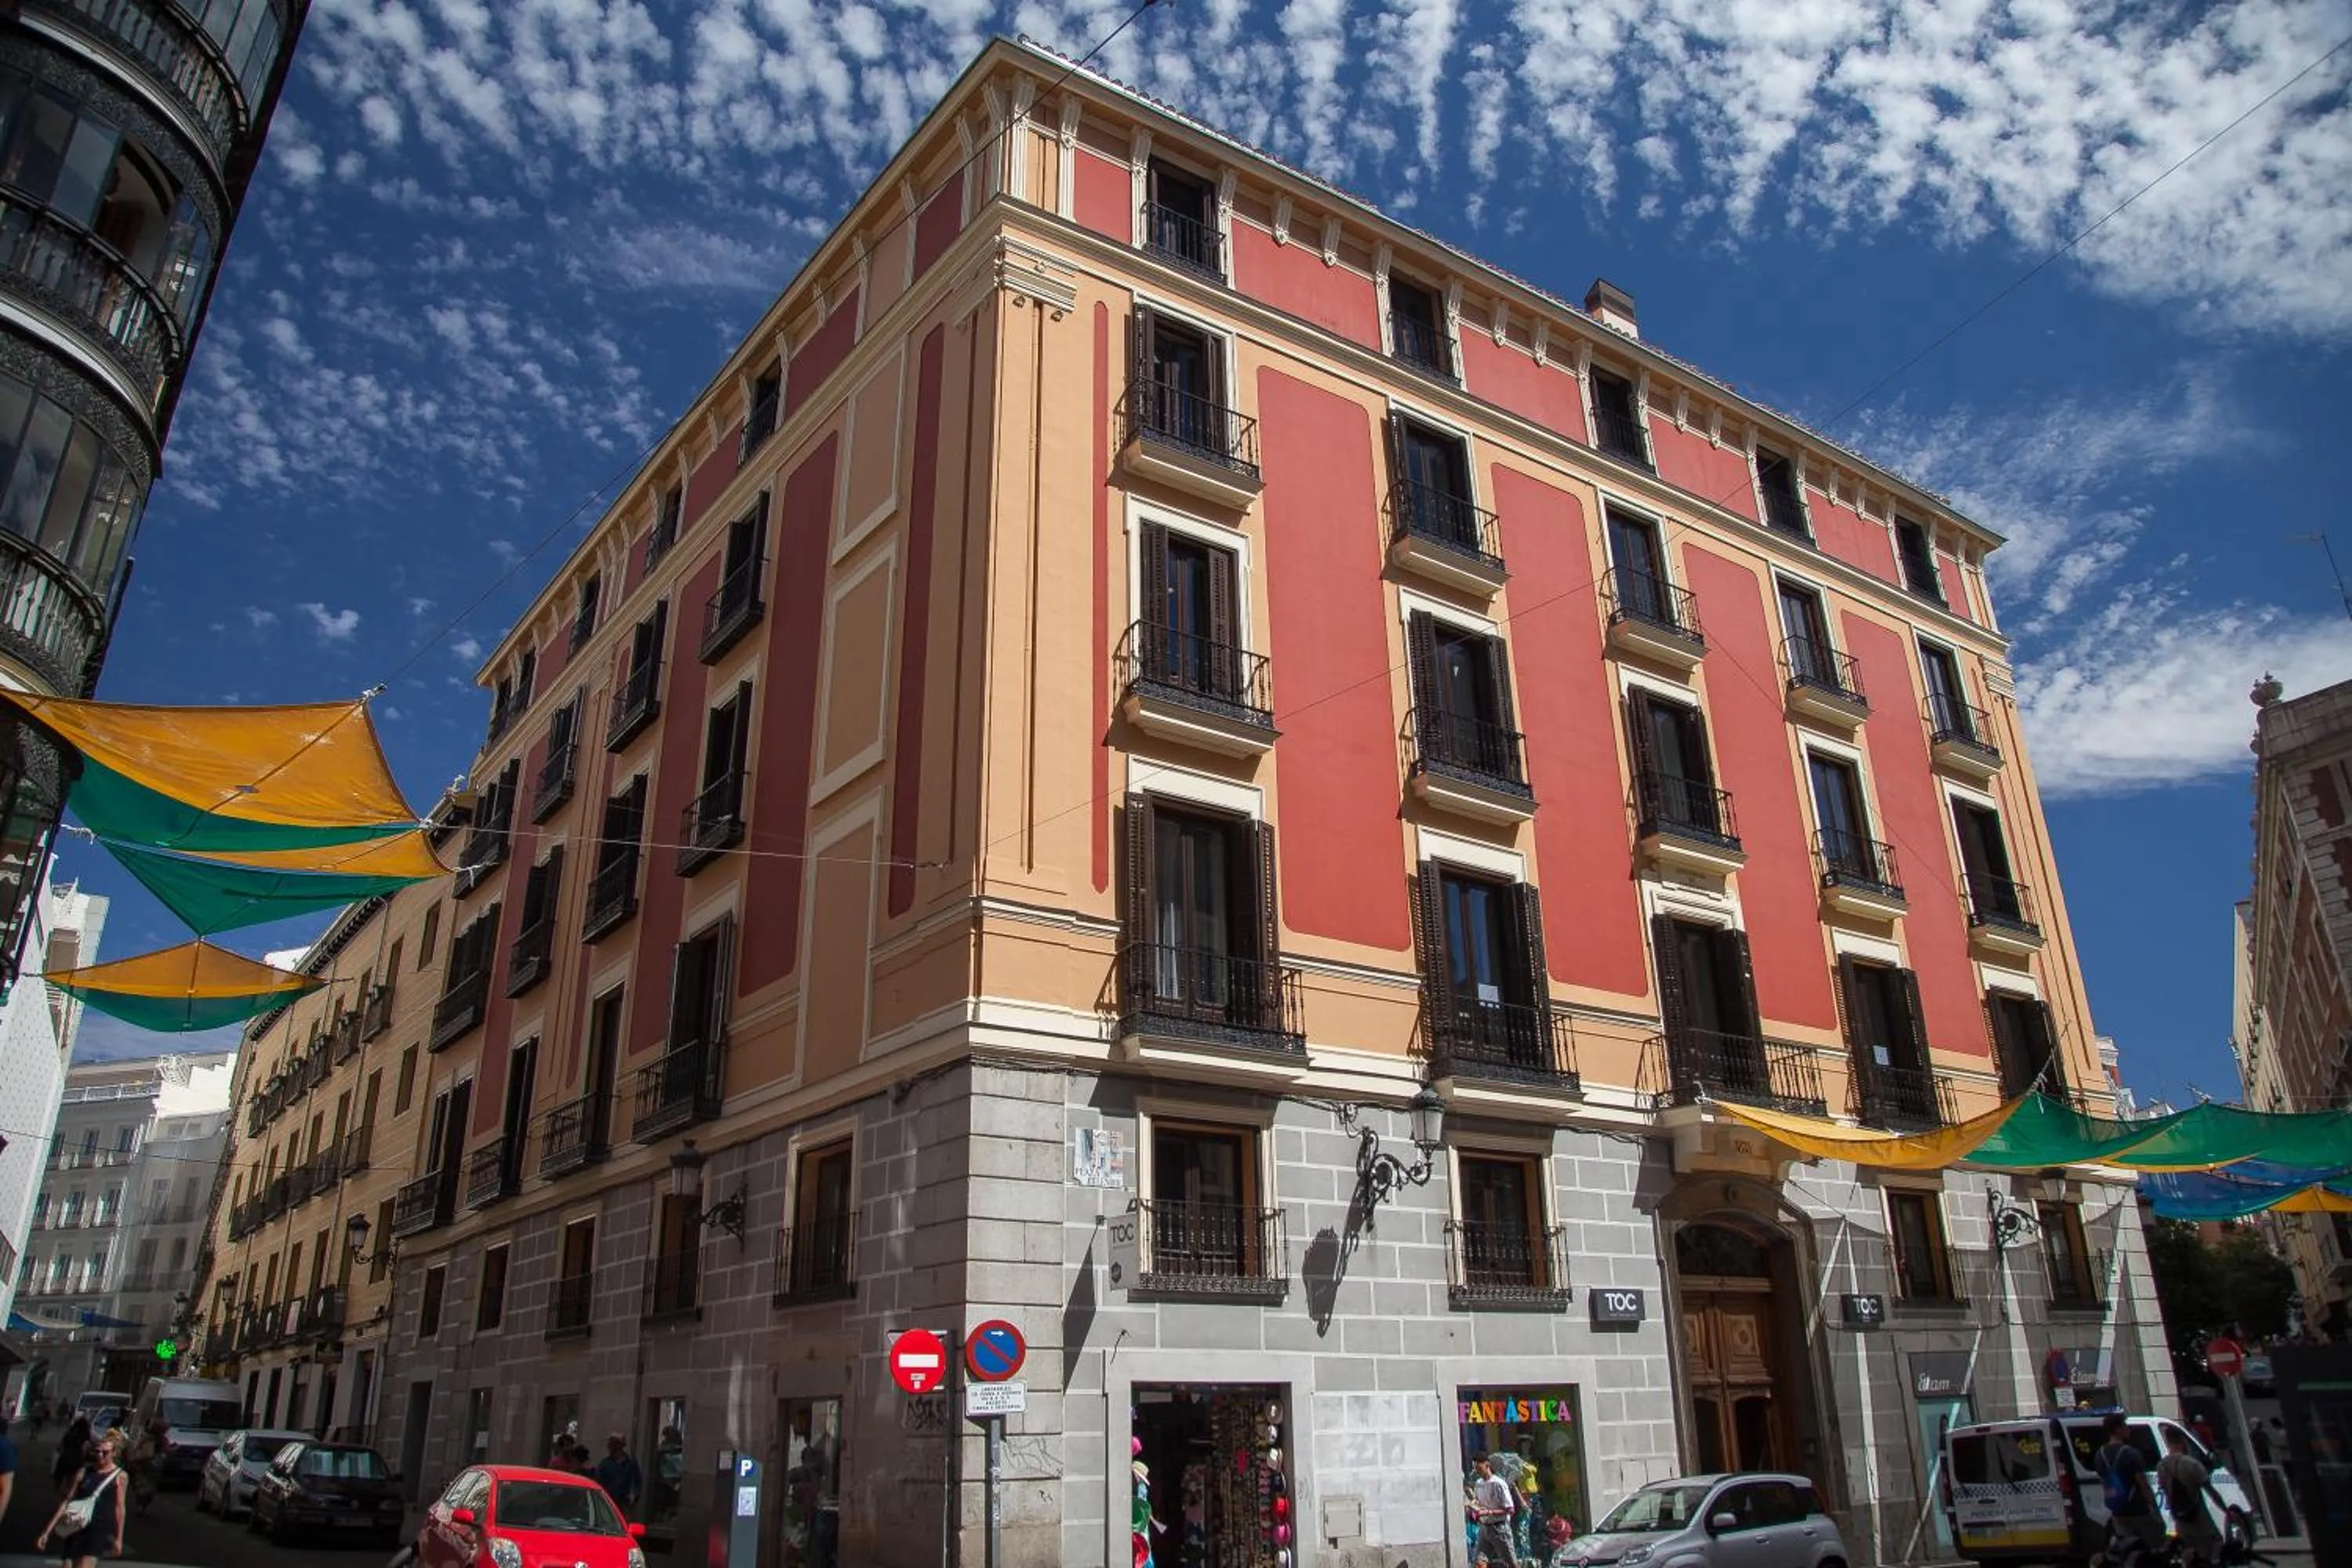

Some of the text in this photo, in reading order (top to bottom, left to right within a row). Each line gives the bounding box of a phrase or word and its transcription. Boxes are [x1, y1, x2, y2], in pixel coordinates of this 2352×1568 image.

[1110, 1223, 1134, 1243] TOC
[1604, 1292, 1638, 1312] TOC
[1853, 1298, 1878, 1315] TOC
[739, 1458, 753, 1477] P
